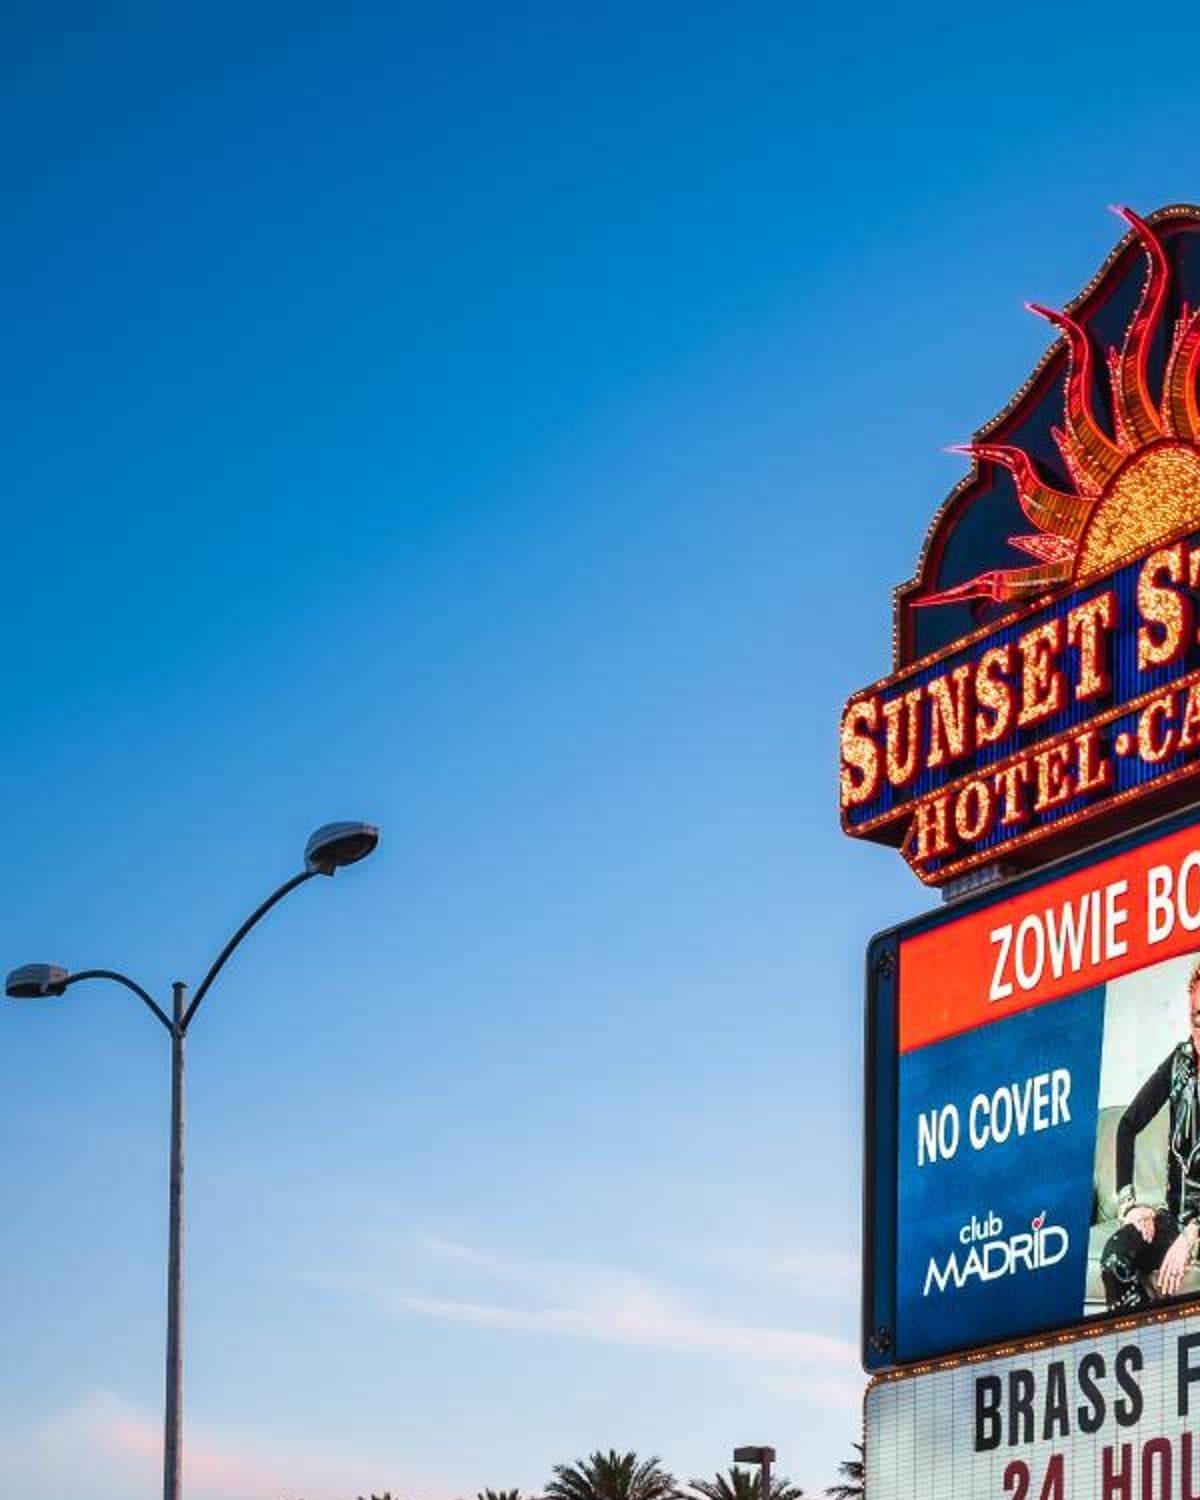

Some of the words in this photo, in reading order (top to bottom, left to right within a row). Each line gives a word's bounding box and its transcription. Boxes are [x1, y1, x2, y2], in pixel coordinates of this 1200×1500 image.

[841, 591, 1118, 807] SUNSET
[988, 879, 1128, 1000] ZOWIE
[917, 1104, 959, 1167] NO
[969, 1068, 1071, 1149] COVER
[960, 1210, 1003, 1244] club
[975, 1344, 1144, 1452] BRASS
